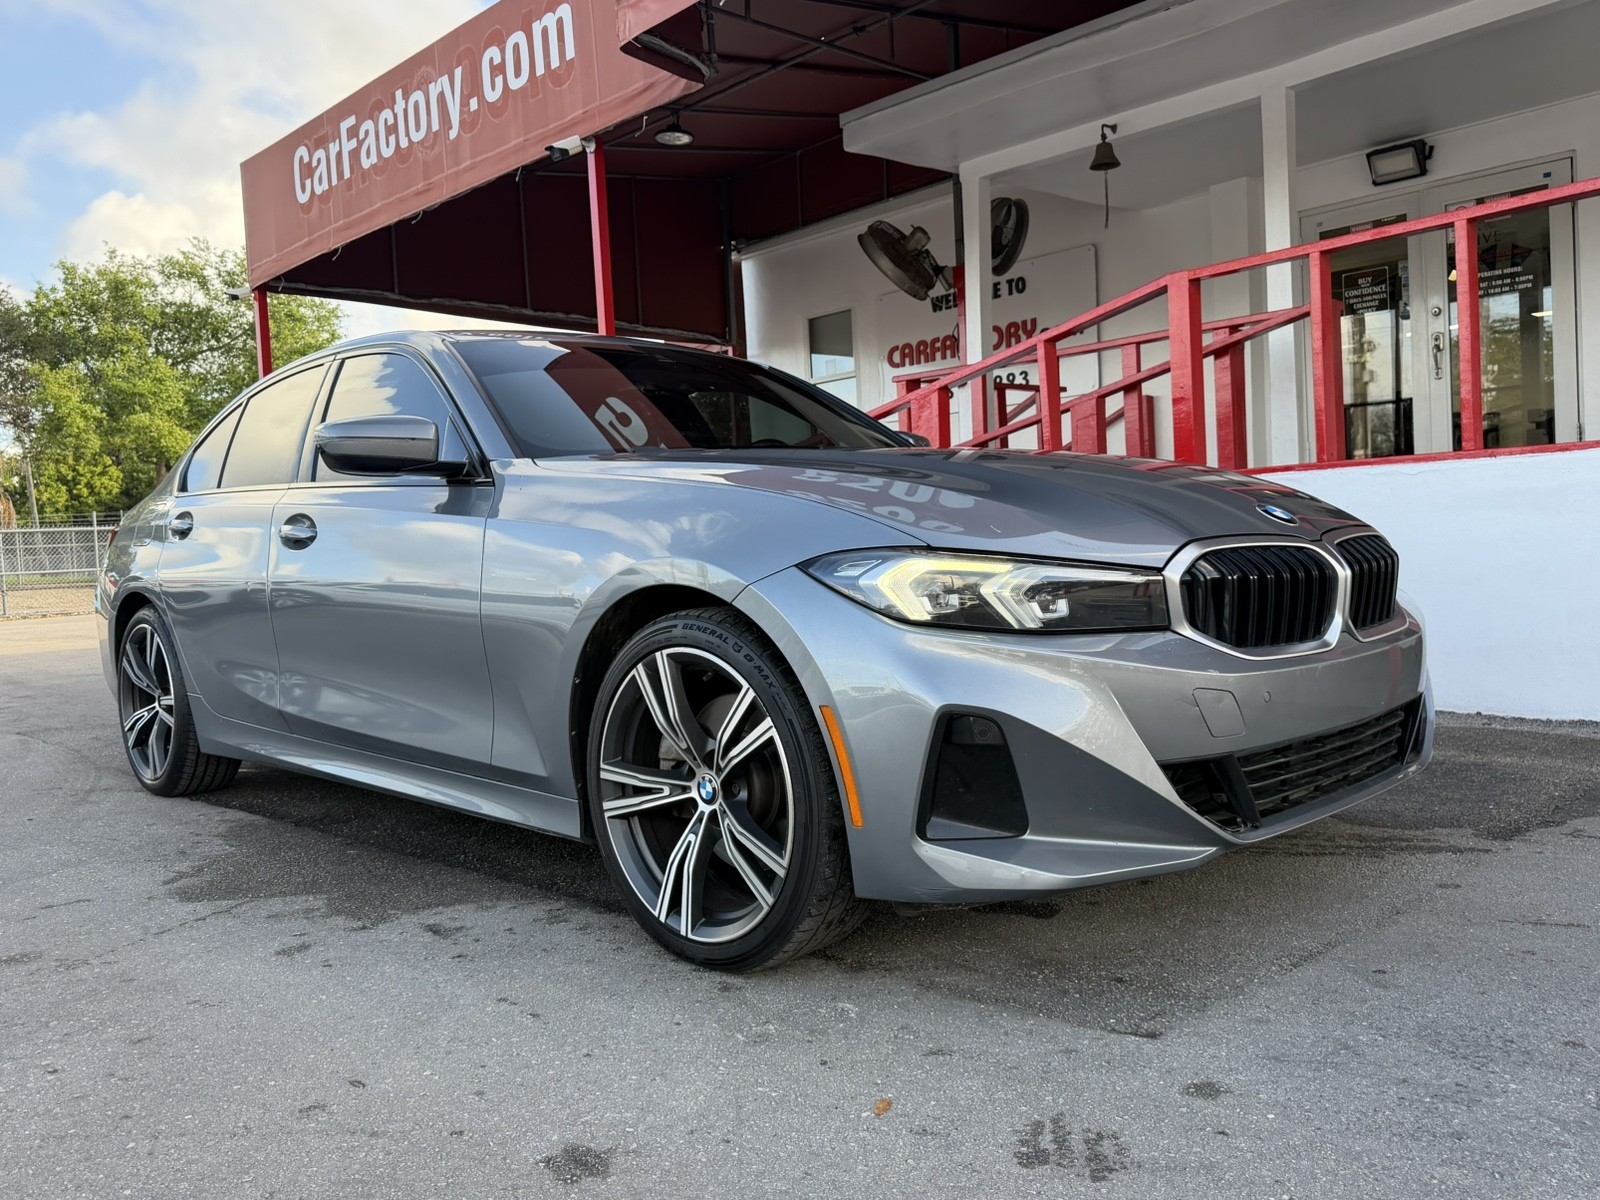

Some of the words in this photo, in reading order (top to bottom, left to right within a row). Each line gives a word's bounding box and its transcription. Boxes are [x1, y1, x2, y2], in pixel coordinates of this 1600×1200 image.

[293, 3, 576, 205] CarFactory.com
[1358, 277, 1372, 285] BUY
[1478, 268, 1502, 278] PERATING
[1006, 276, 1026, 296] TO
[1345, 284, 1387, 298] CONFIDENCE
[681, 622, 730, 646] GENERAL
